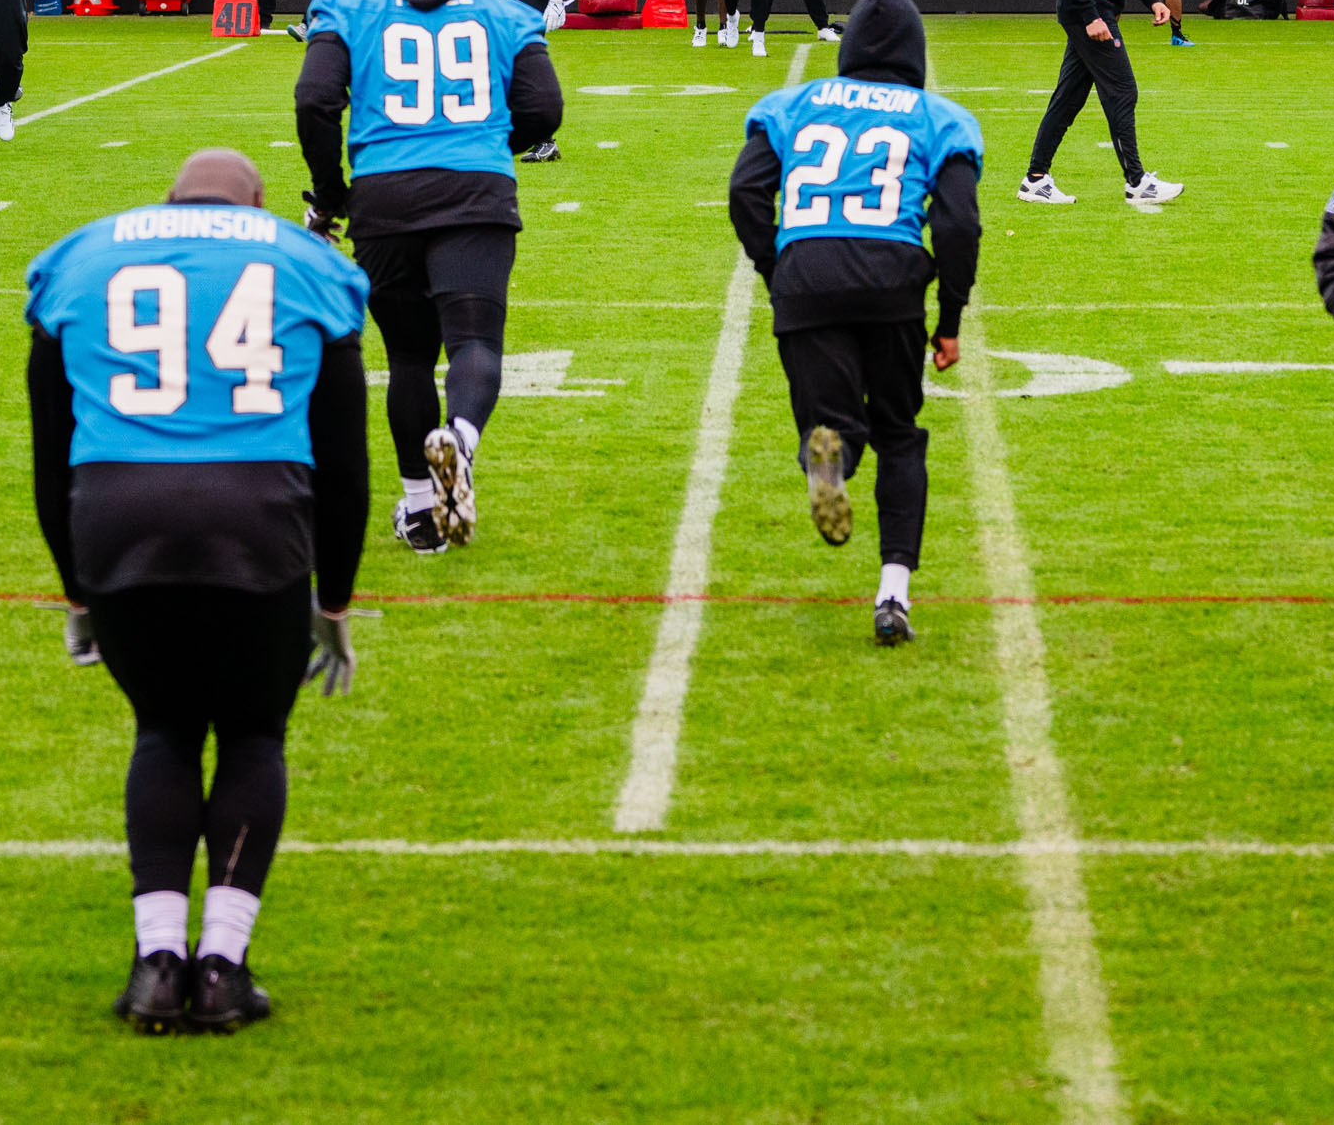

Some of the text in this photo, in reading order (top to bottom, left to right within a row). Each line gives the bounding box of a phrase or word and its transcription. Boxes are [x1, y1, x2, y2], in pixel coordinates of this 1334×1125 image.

[215, 2, 252, 35] 40
[382, 19, 491, 125] 99
[811, 82, 919, 114] JACKSON
[783, 123, 911, 230] 23
[113, 209, 277, 243] ROBINSON
[107, 262, 284, 416] 94
